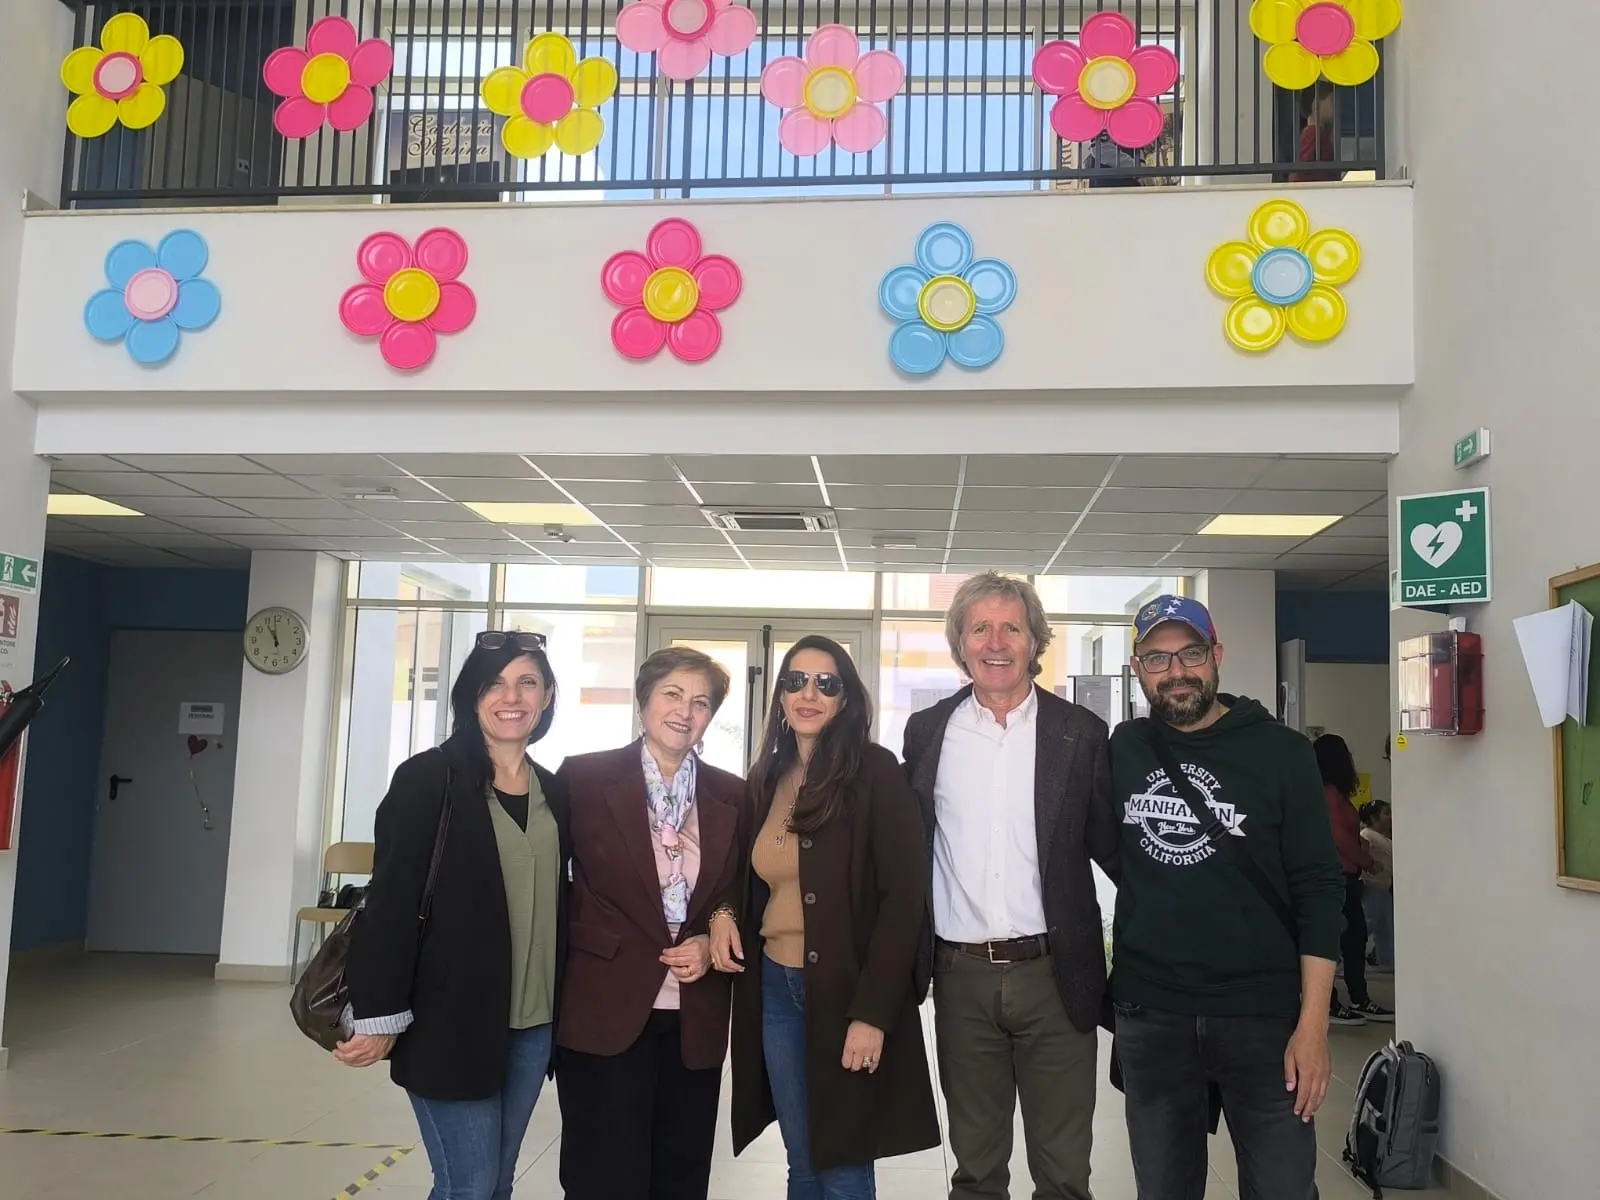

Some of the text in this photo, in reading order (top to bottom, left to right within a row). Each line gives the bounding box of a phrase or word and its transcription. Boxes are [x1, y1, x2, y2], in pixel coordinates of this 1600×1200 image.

[1406, 584, 1437, 598] DAE
[1449, 581, 1482, 596] AED
[1146, 763, 1222, 790] UNERSITY
[1157, 821, 1195, 833] New York
[1140, 838, 1216, 866] CALIFORNIA
